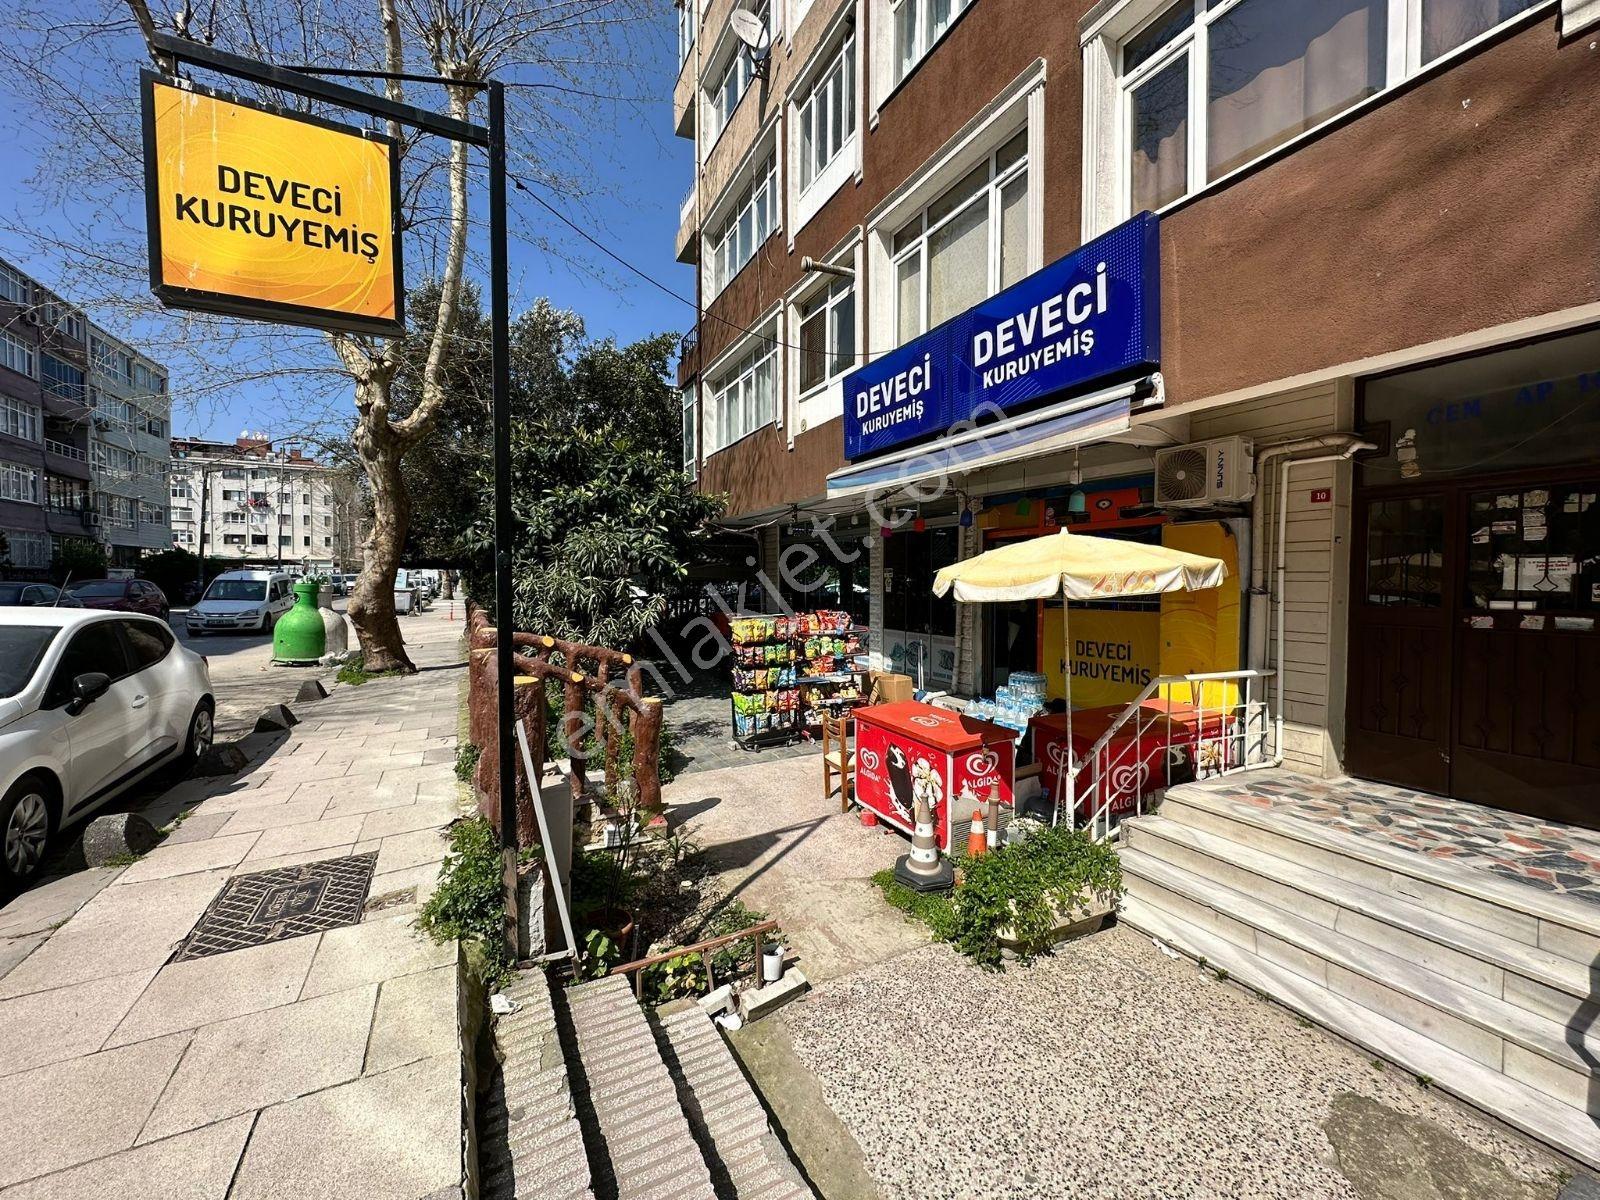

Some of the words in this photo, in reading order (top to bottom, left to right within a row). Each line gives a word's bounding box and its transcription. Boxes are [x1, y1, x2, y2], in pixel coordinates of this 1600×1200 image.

[217, 164, 342, 216] DEVECİ
[175, 193, 380, 264] KURUYEMİŞ
[973, 261, 1108, 367] DEVECİ
[856, 352, 931, 418] DEVECİ
[982, 329, 1095, 389] KURUYEMİŞ
[861, 400, 924, 436] KURUYEMİŞ
[1216, 450, 1224, 489] SUNNY
[1316, 492, 1327, 500] 10
[1075, 639, 1131, 661] DEVECİ
